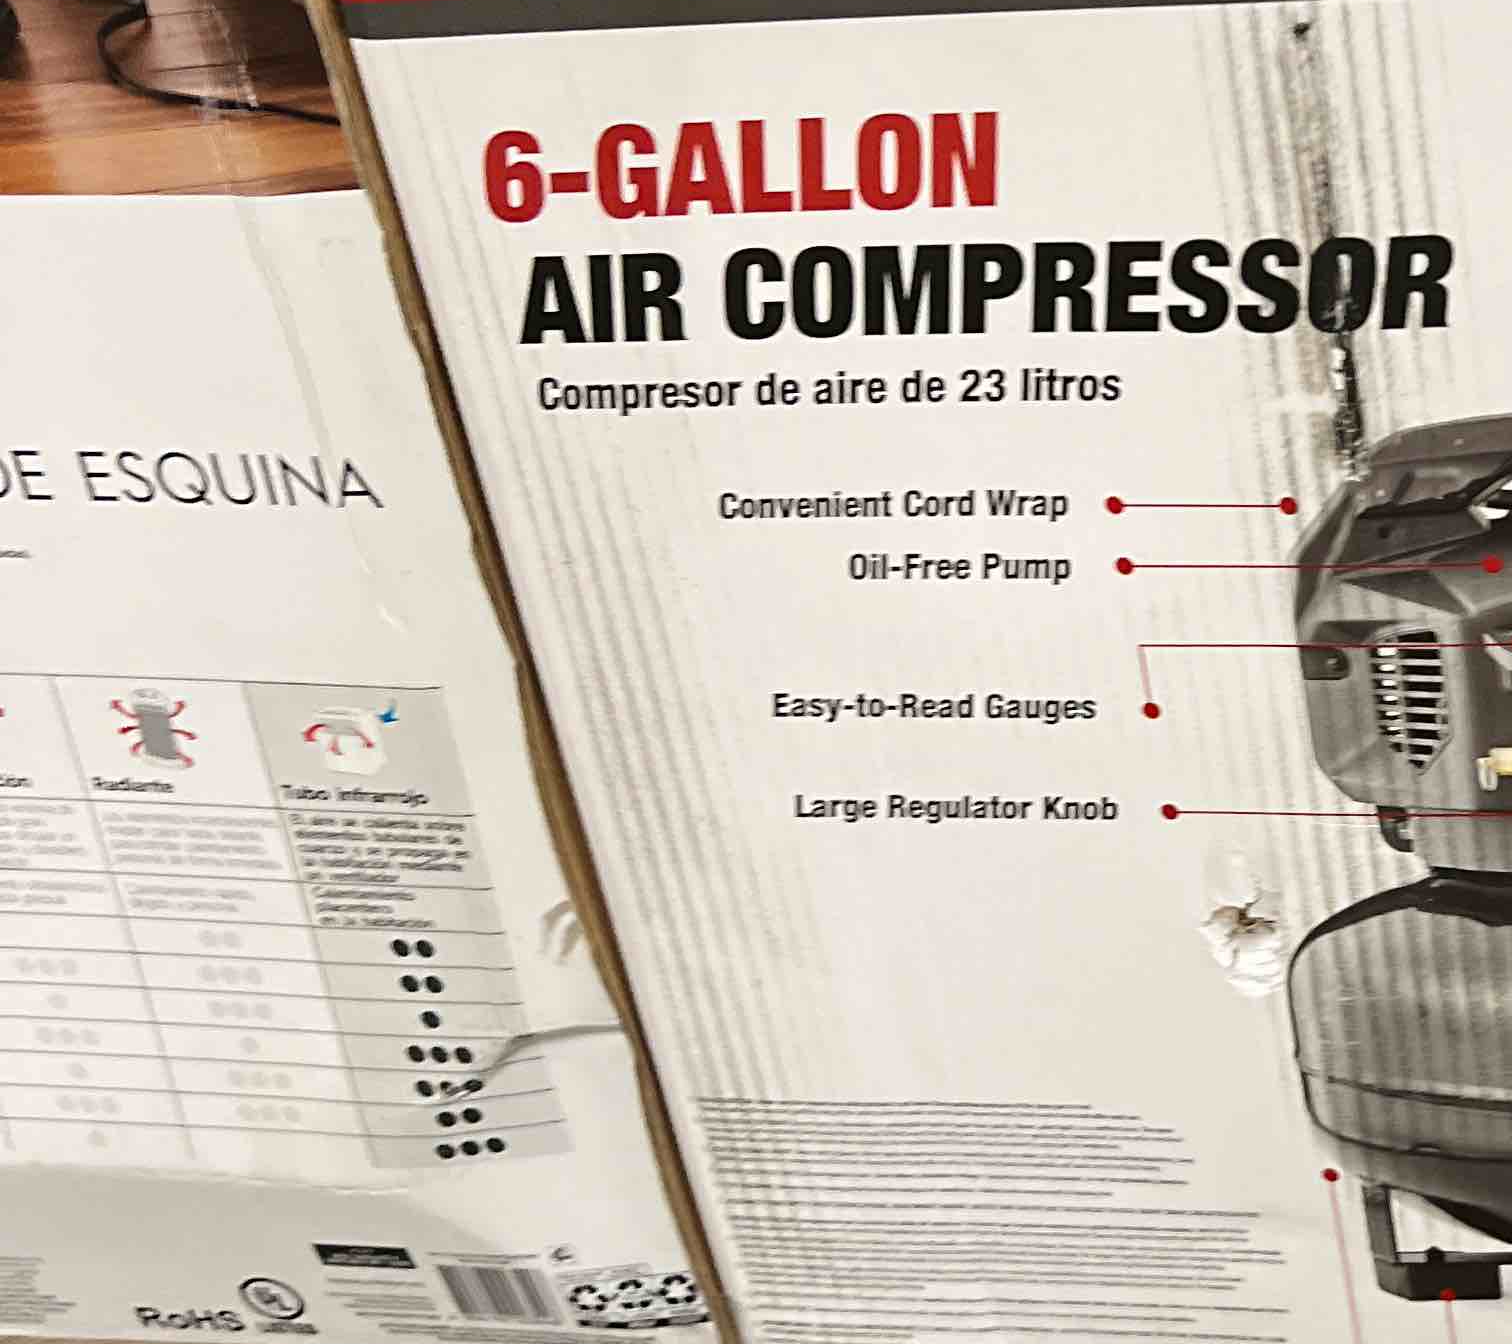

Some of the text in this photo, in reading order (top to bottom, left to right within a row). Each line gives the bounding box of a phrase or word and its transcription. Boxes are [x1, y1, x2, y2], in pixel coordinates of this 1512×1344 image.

[483, 111, 998, 224] 6-GALLON
[519, 233, 1455, 345] AIR COMPRESSOR
[539, 367, 1121, 417] Compresor de aire de 23 litros
[77, 451, 384, 509] ESQUINA
[719, 489, 1068, 523] Convenient Cord Wrap
[849, 552, 1071, 586] Oil-Free Pump
[773, 692, 1097, 725] Easy-to-Read Gauges
[795, 794, 1118, 824] Large Regulator Knob
[135, 1306, 246, 1332] RoHS
